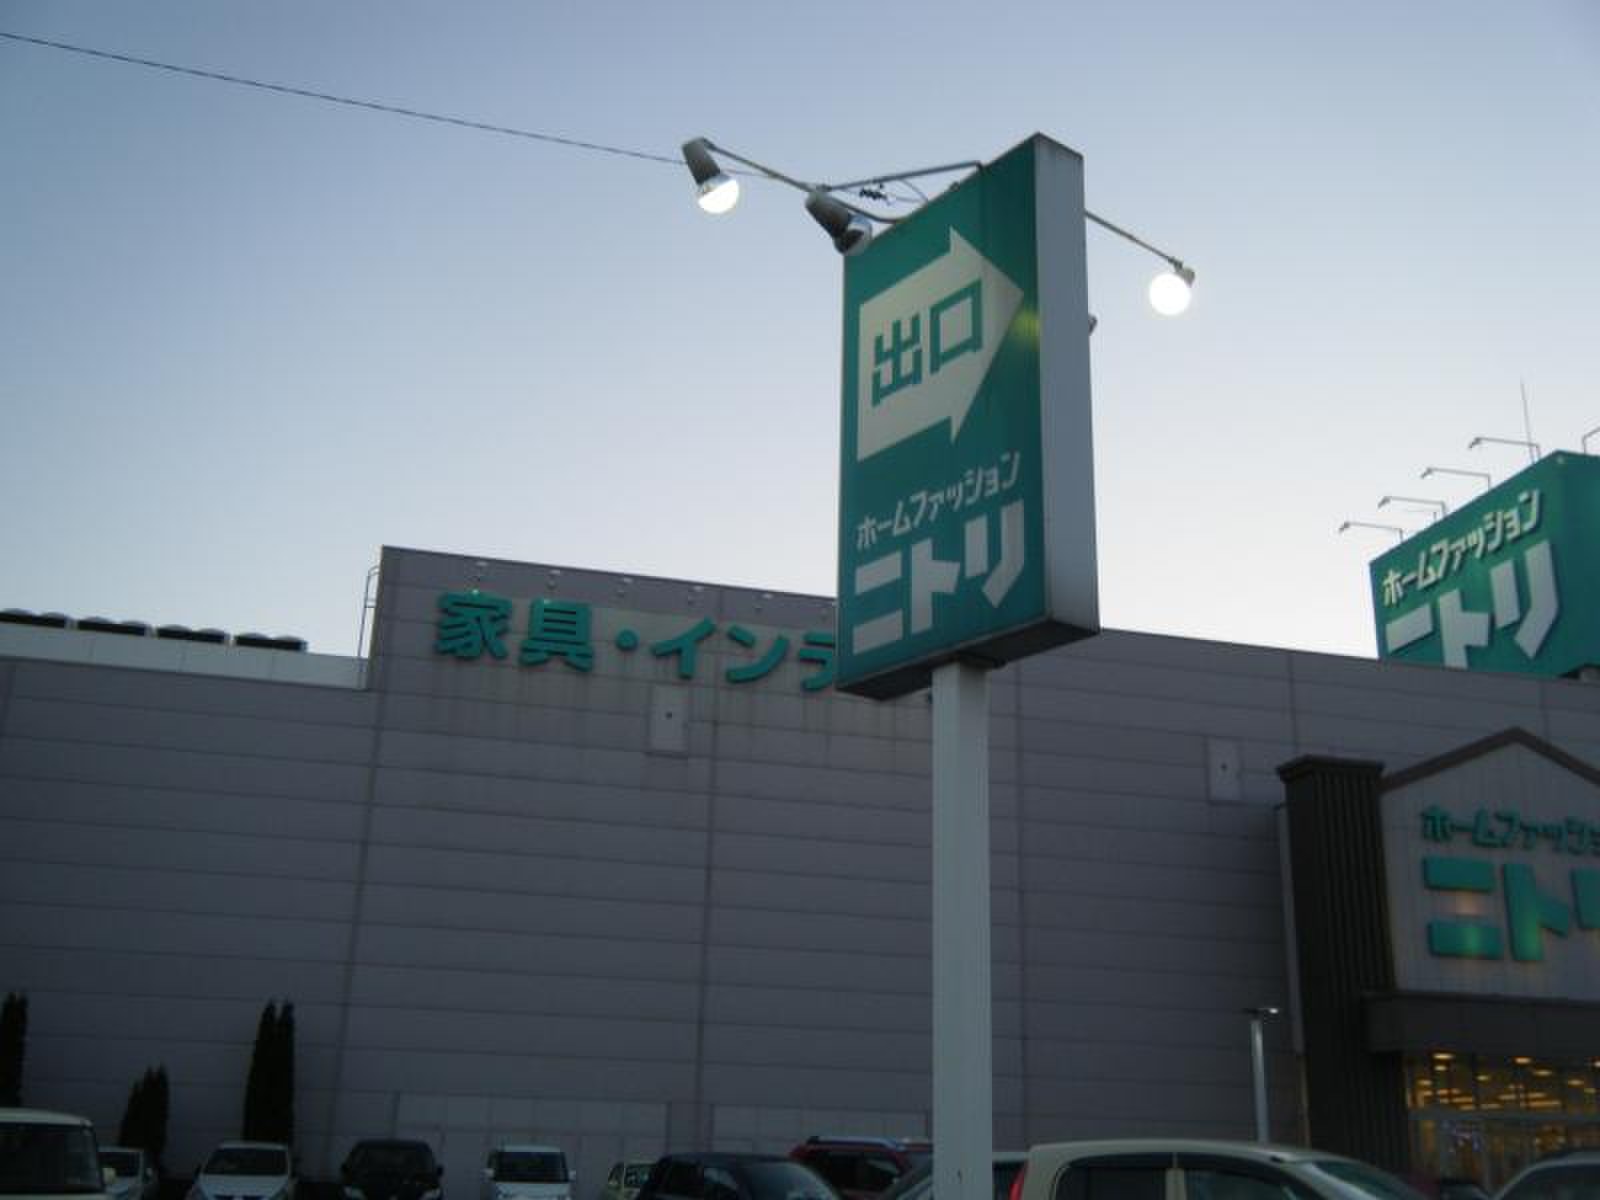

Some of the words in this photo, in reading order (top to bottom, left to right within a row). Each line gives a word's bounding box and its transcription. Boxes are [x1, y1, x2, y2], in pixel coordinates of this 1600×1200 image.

[872, 280, 982, 407] 出口
[857, 452, 1020, 549] ホームファッション
[1384, 489, 1539, 606] ホームファッション
[853, 500, 1024, 655] ニトリ
